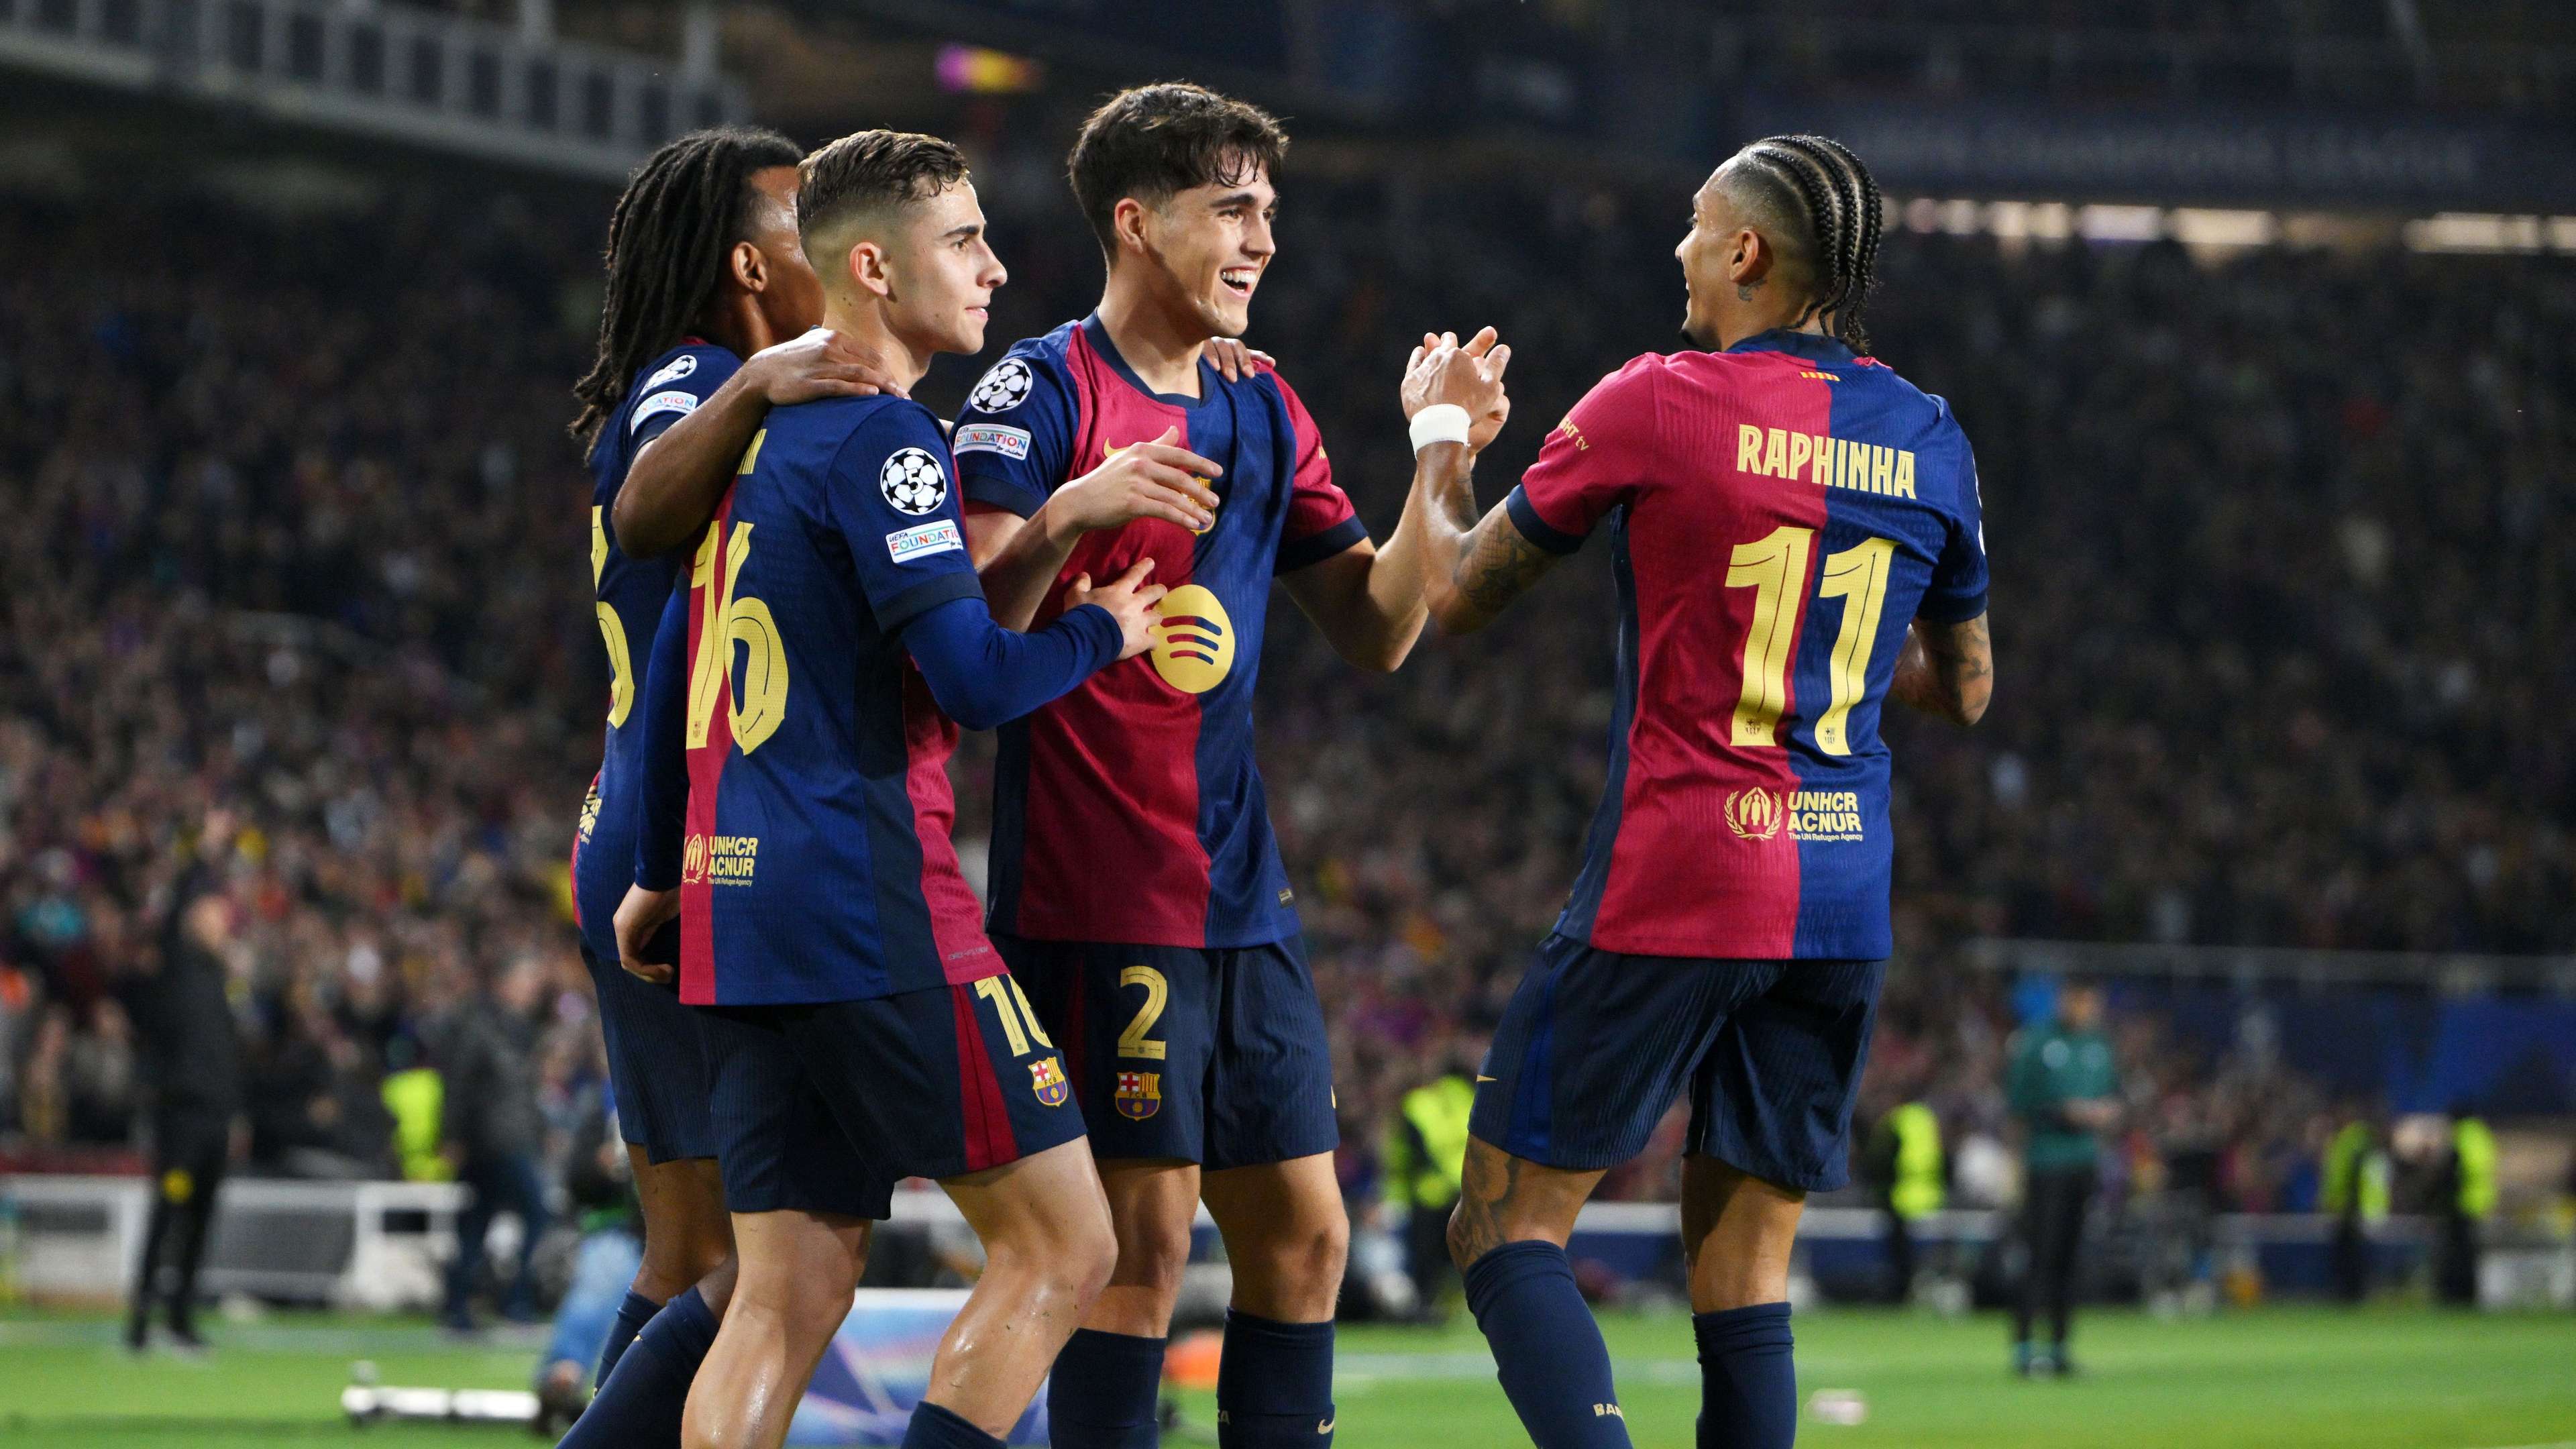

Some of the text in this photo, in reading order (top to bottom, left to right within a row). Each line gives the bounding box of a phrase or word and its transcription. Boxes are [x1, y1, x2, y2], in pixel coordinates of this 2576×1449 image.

[991, 374, 1008, 396] 5
[1737, 424, 1917, 500] RAPHINHA
[905, 467, 924, 495] 5
[889, 532, 908, 543] UEFA
[686, 520, 789, 756] 16
[1725, 526, 1902, 755] 11
[1788, 792, 1858, 812] UNHCR
[1786, 812, 1862, 833] ACNUR
[708, 836, 758, 856] UNHCR
[1788, 832, 1863, 842] The UN Refugee Agency
[707, 856, 755, 876] ACNUR
[1118, 965, 1168, 1060] 2
